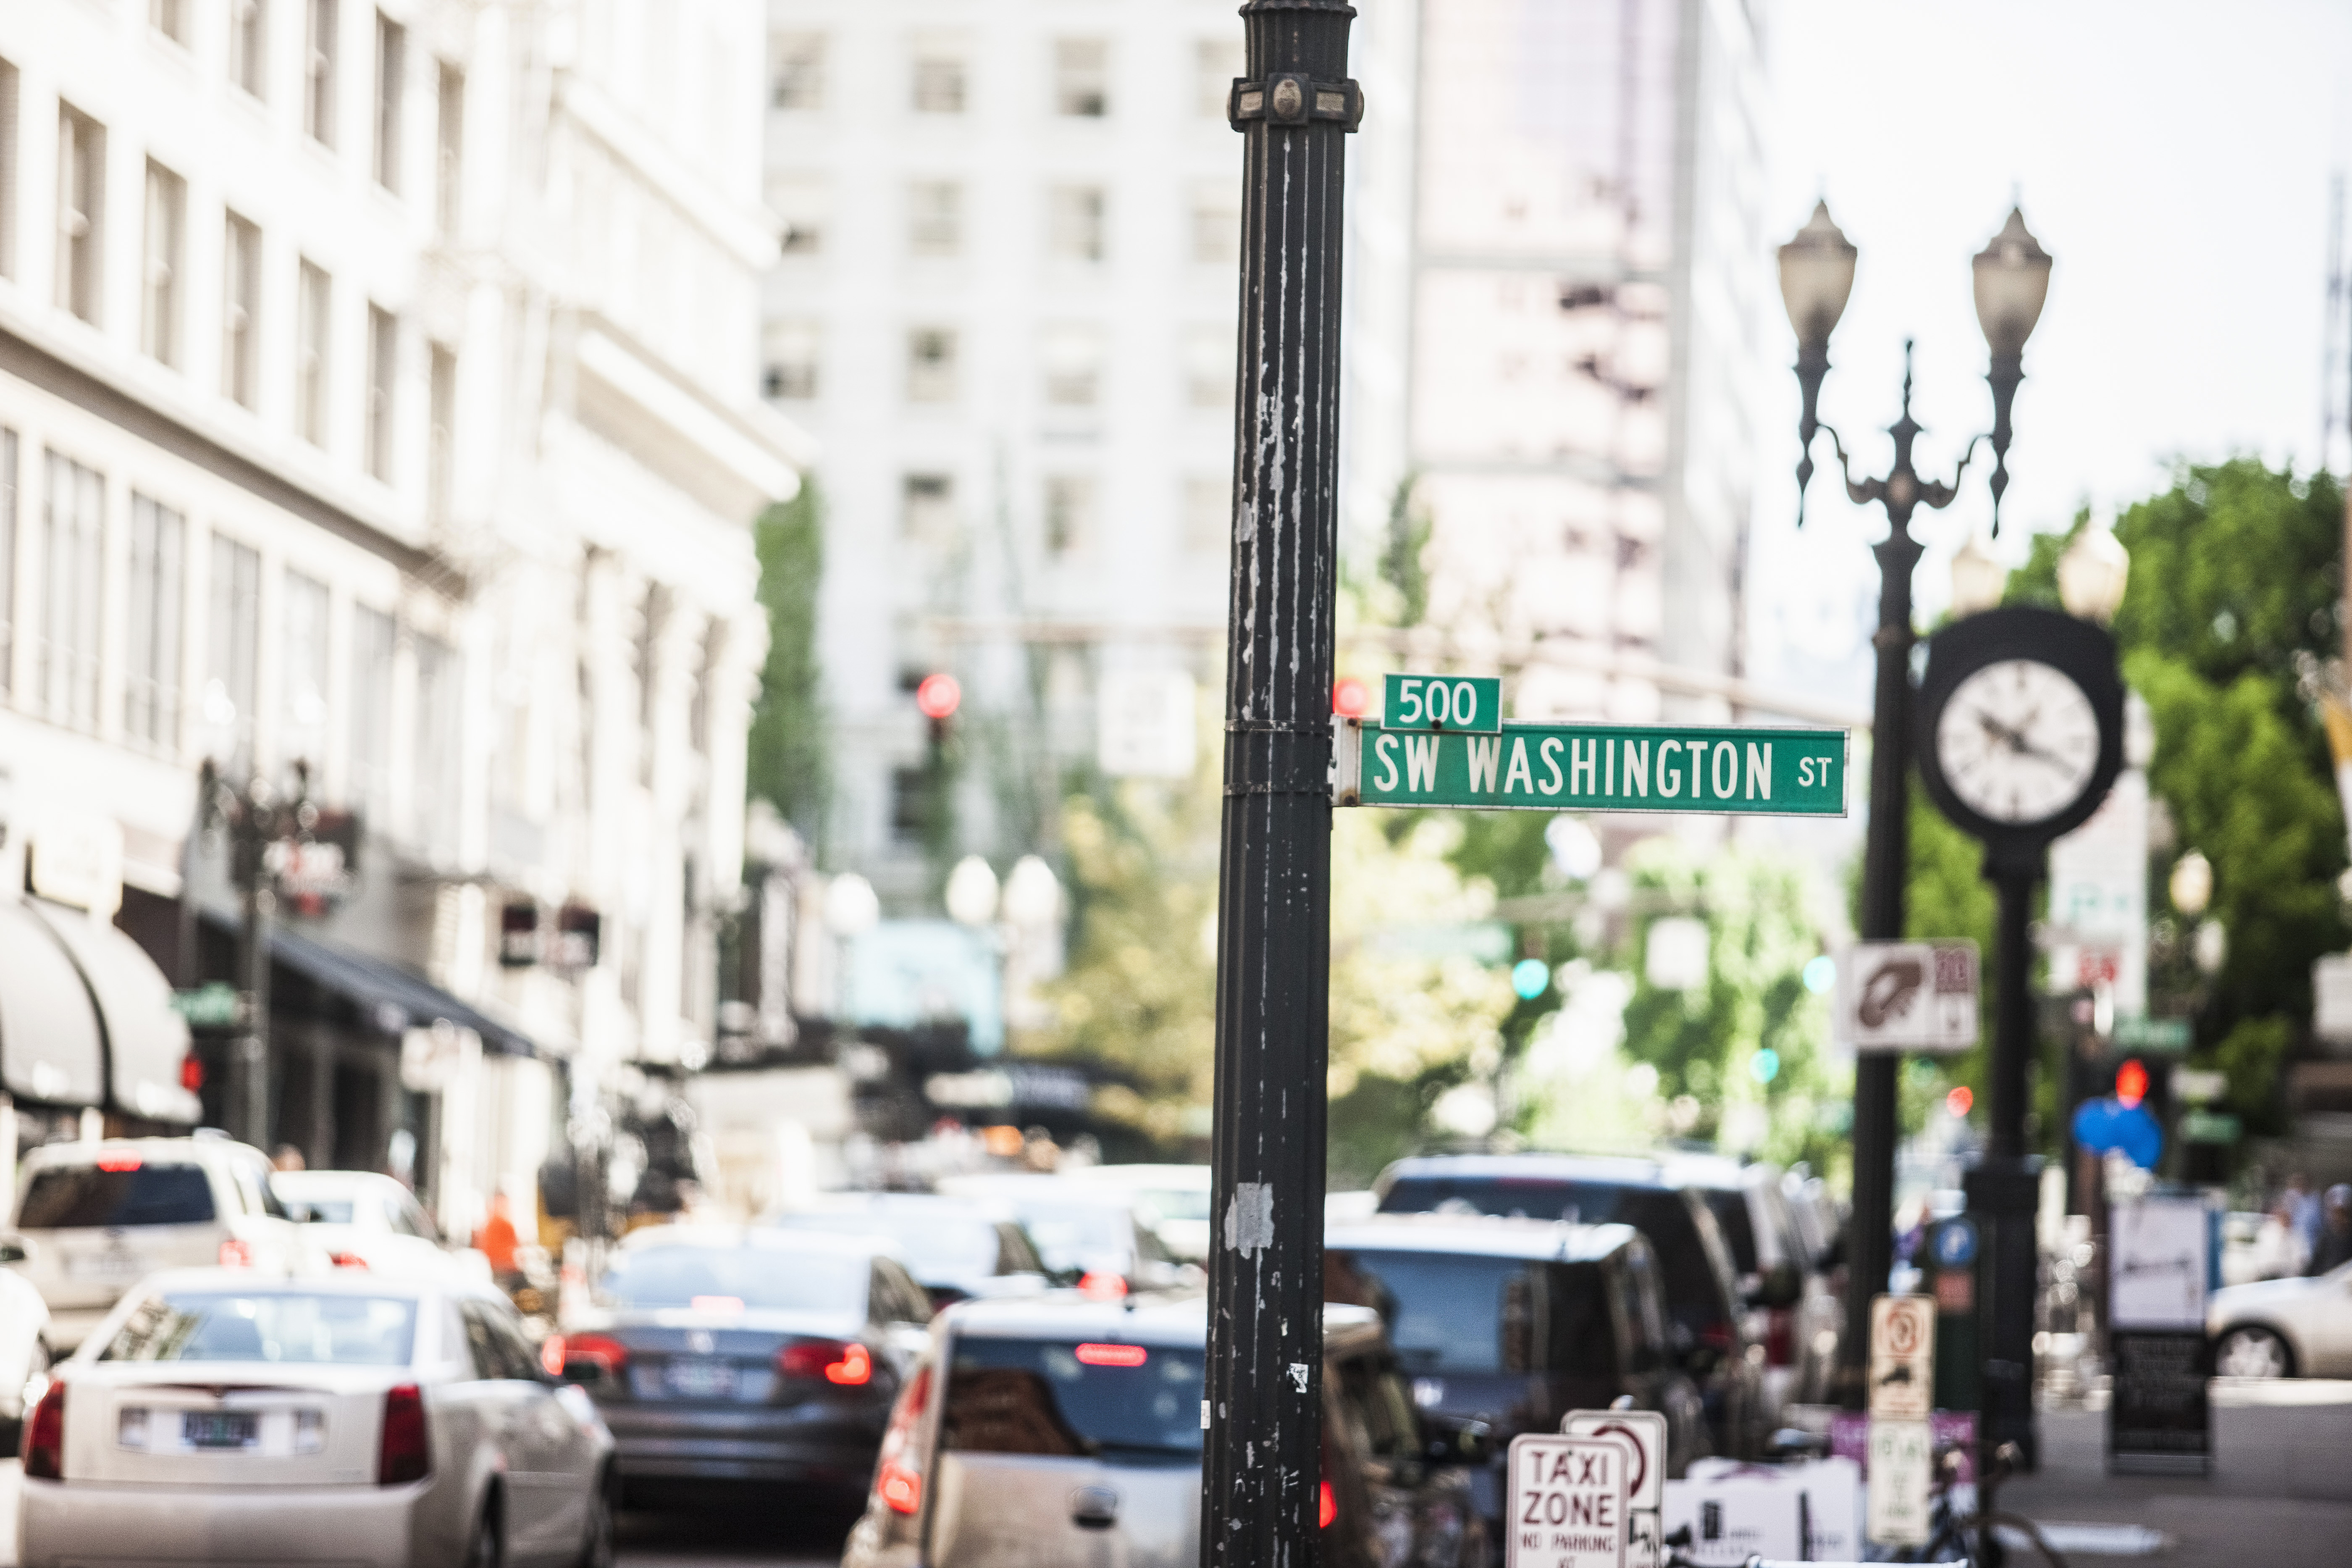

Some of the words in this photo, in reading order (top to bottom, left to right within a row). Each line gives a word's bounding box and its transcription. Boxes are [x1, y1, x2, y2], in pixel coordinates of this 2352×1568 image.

[1399, 679, 1478, 725] 500
[1374, 733, 1440, 792] SW
[1467, 736, 1772, 800] WASHINGTON
[1798, 756, 1832, 787] ST
[1532, 1451, 1608, 1486] TAXI
[1523, 1491, 1614, 1527] ZONE
[1522, 1534, 1541, 1549] NO
[1551, 1534, 1614, 1552] PARKING
